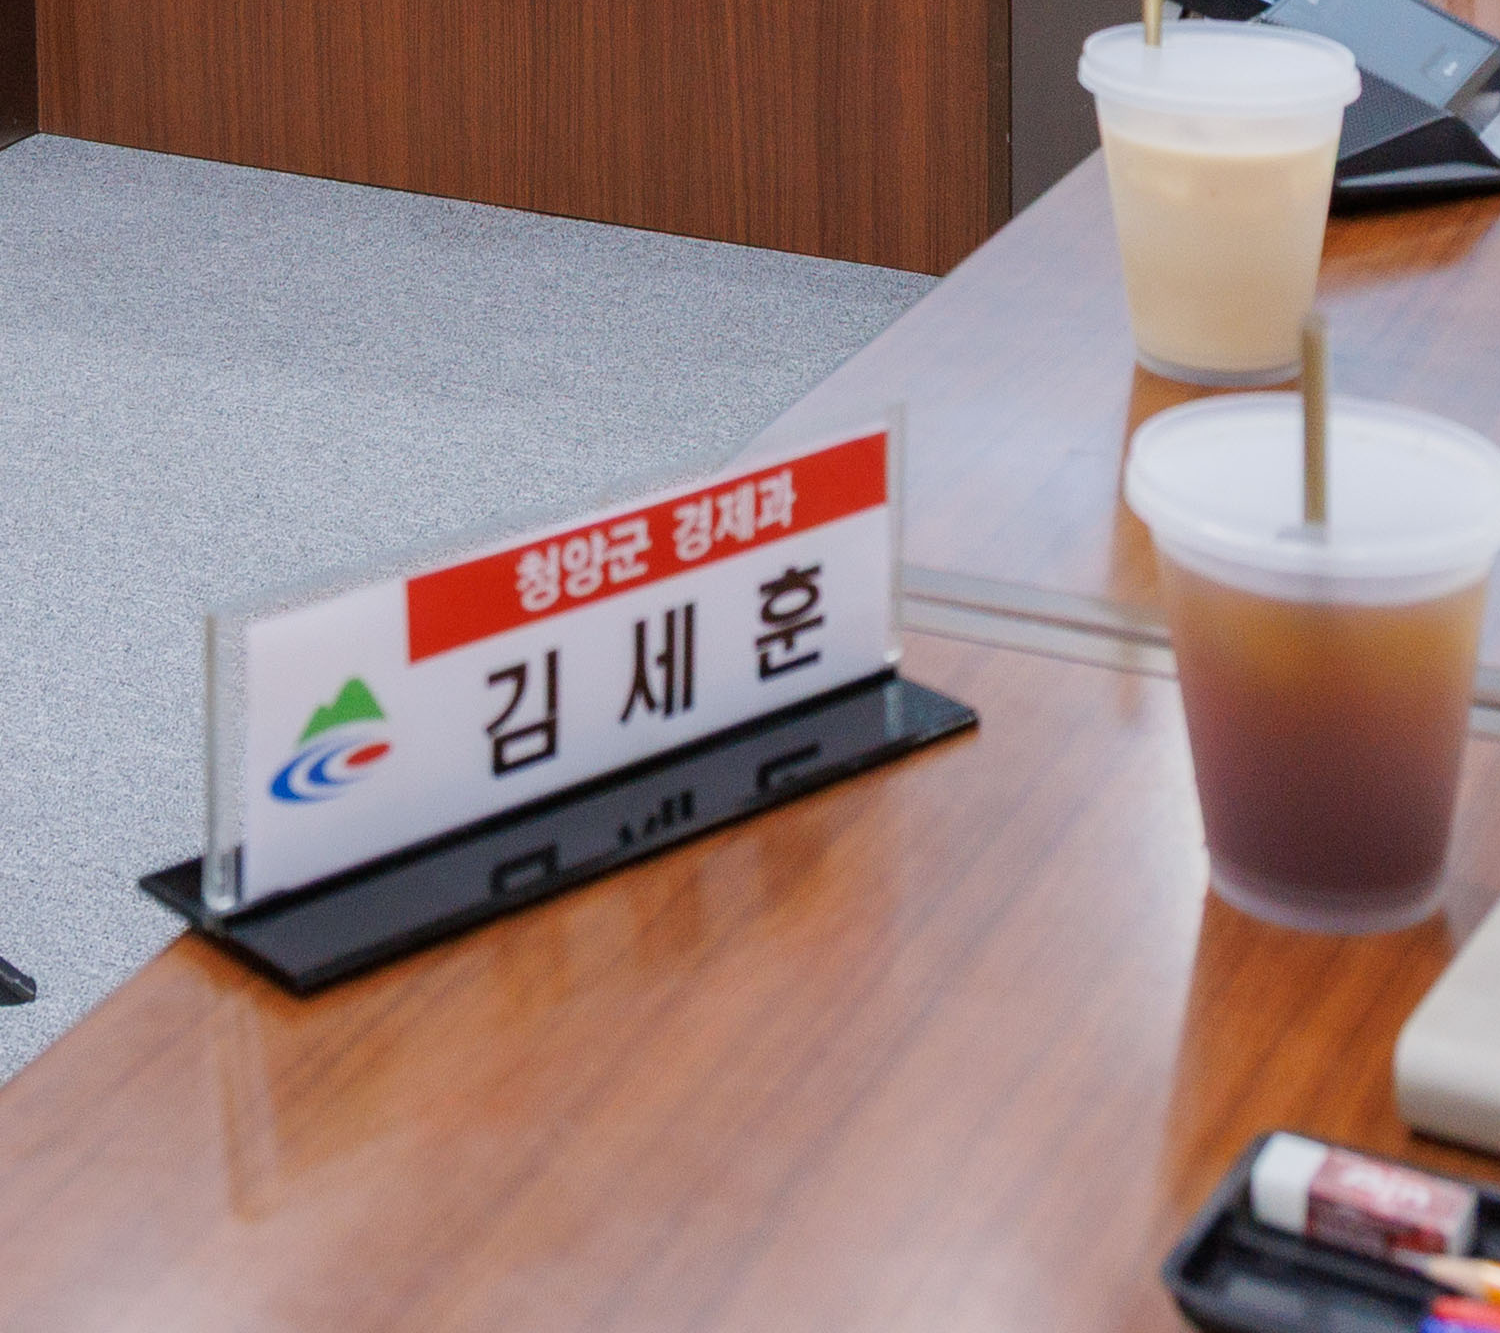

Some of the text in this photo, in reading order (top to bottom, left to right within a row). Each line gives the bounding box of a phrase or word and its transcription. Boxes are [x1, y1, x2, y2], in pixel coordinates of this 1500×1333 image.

[515, 468, 797, 613] 청양군 경제과
[486, 562, 824, 778] 김세훈
